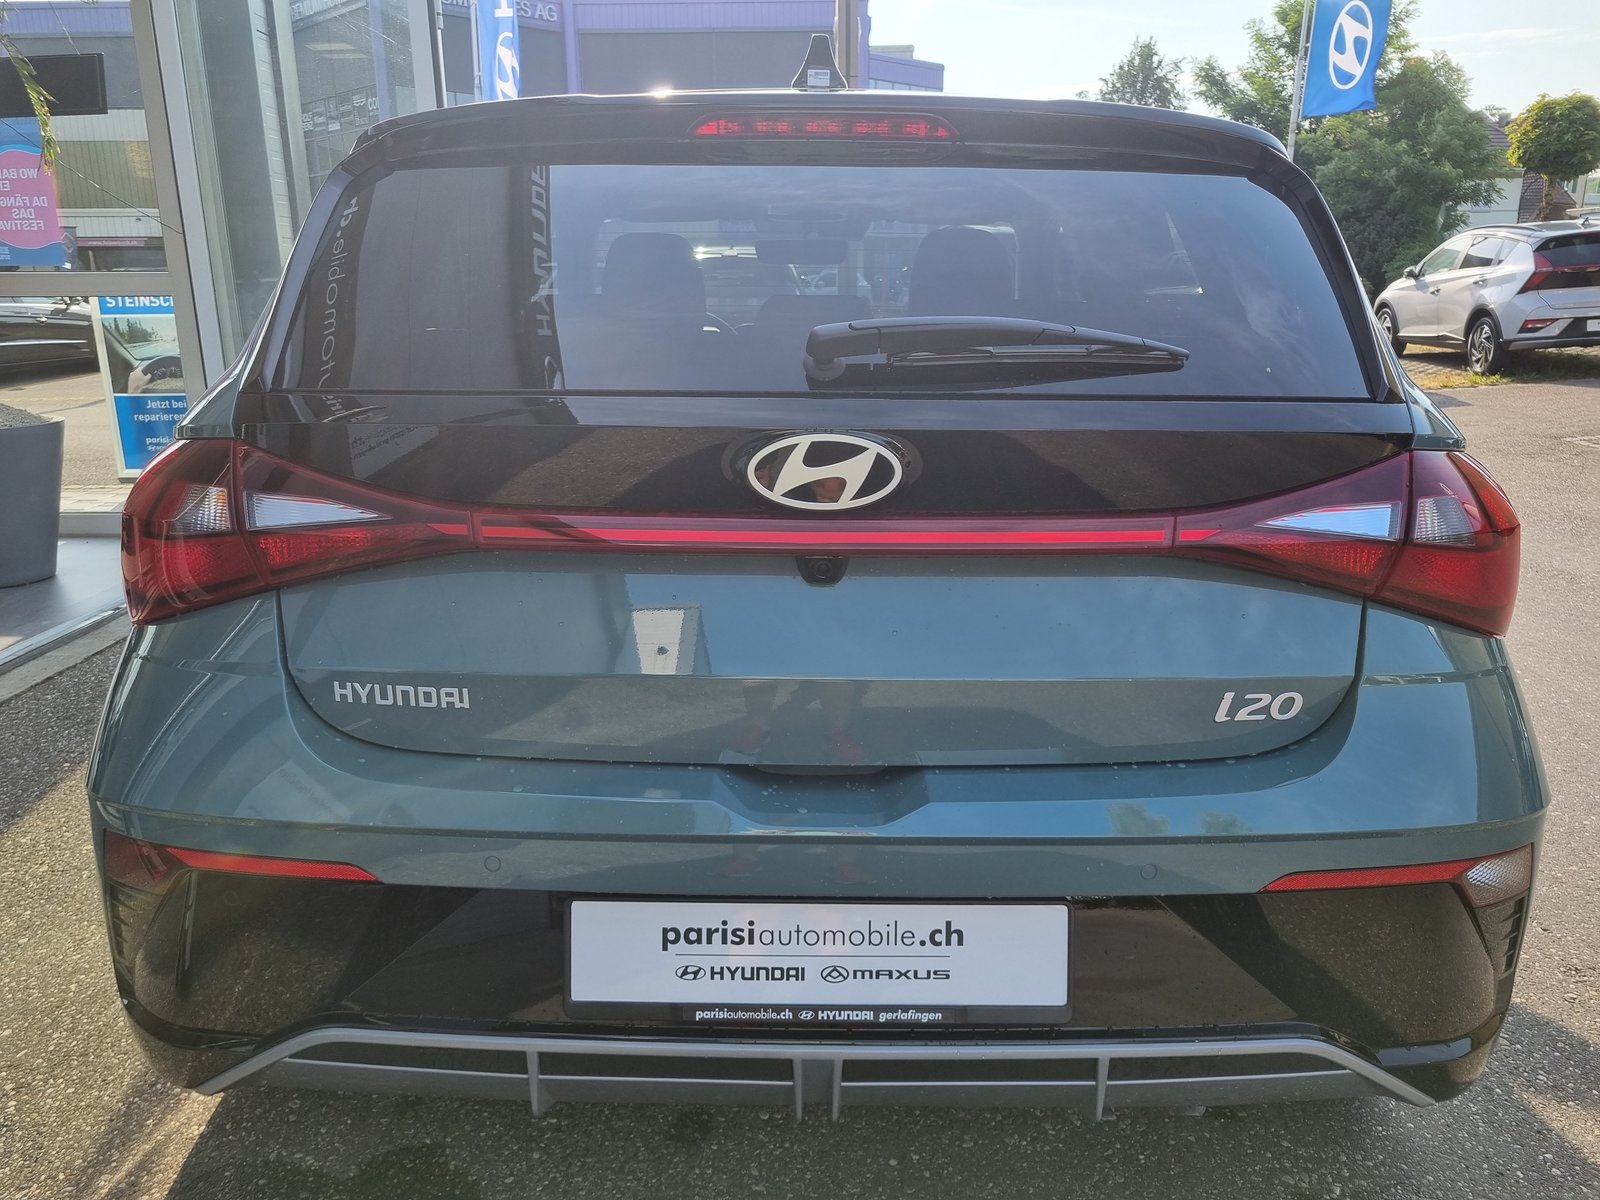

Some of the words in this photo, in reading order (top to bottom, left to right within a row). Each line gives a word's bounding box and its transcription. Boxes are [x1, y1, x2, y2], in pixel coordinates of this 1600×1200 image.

[516, 1, 532, 17] ES
[535, 5, 558, 21] AG
[146, 400, 170, 409] Jetzt
[171, 400, 187, 408] bei
[333, 681, 470, 709] HYUNDAI
[1214, 692, 1304, 723] i20
[661, 920, 964, 951] parisiautomobile.ch
[710, 966, 805, 981] HYUNDAI
[853, 969, 951, 980] MAXUS
[695, 1008, 793, 1021] parisiautomobile.ch
[818, 1011, 874, 1021] HYUNDAI
[878, 1009, 942, 1023] gerlafingen
